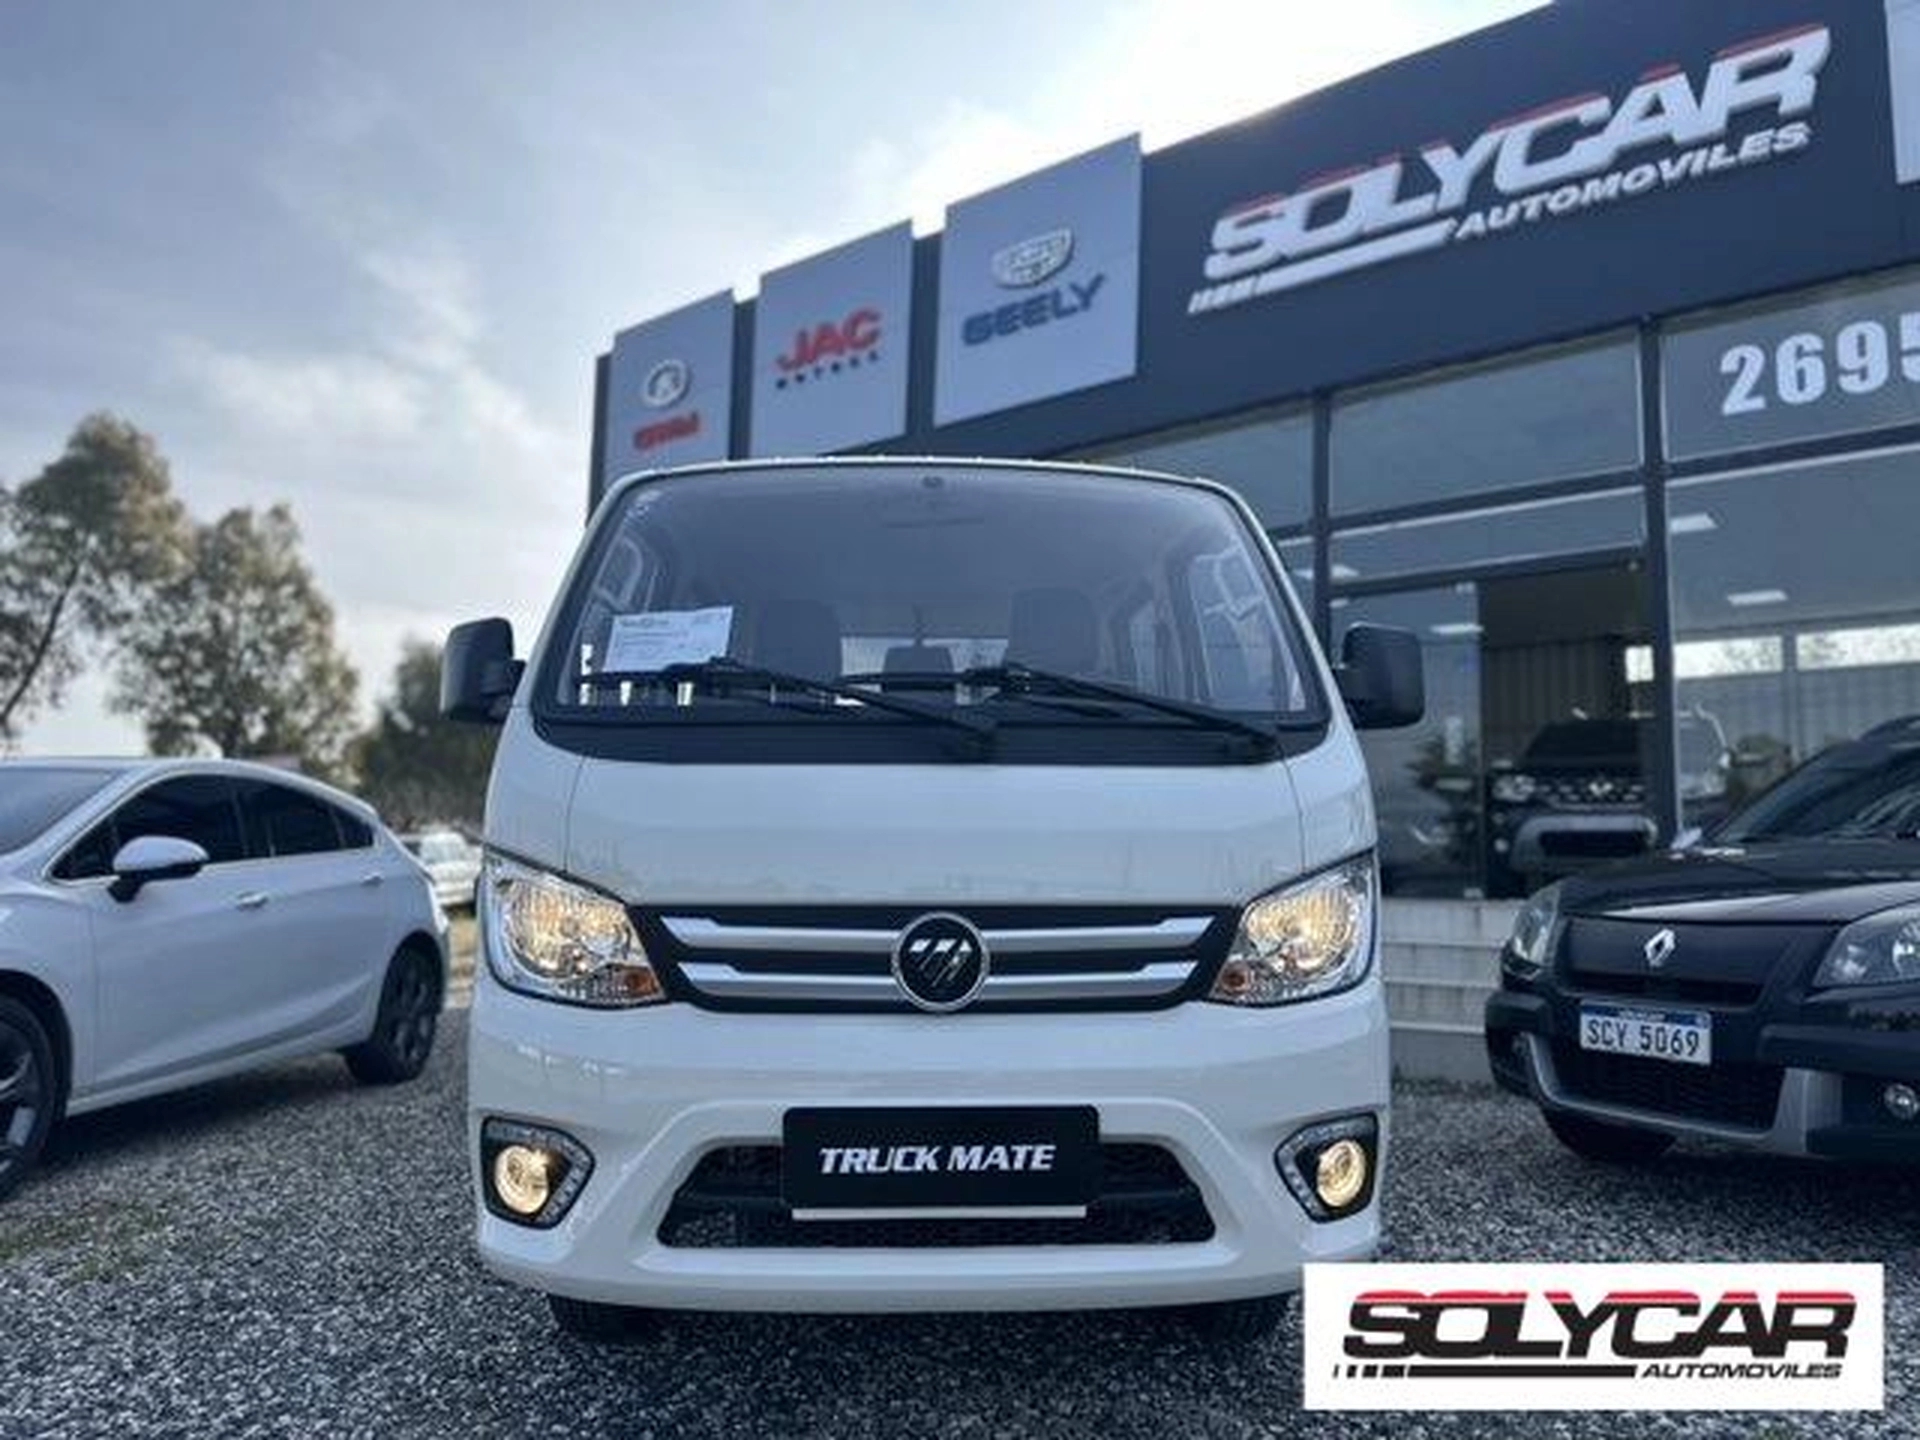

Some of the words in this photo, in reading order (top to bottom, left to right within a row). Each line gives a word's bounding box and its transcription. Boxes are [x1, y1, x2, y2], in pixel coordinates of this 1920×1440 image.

[1204, 23, 1831, 280] SOLYCAR
[1455, 121, 1812, 242] AUTOMOVILES
[775, 308, 882, 371] JAC
[1587, 1018, 1627, 1047] SCY
[1640, 1025, 1699, 1056] 5069
[819, 1147, 941, 1174] TRUCK
[947, 1145, 1057, 1172] MATE
